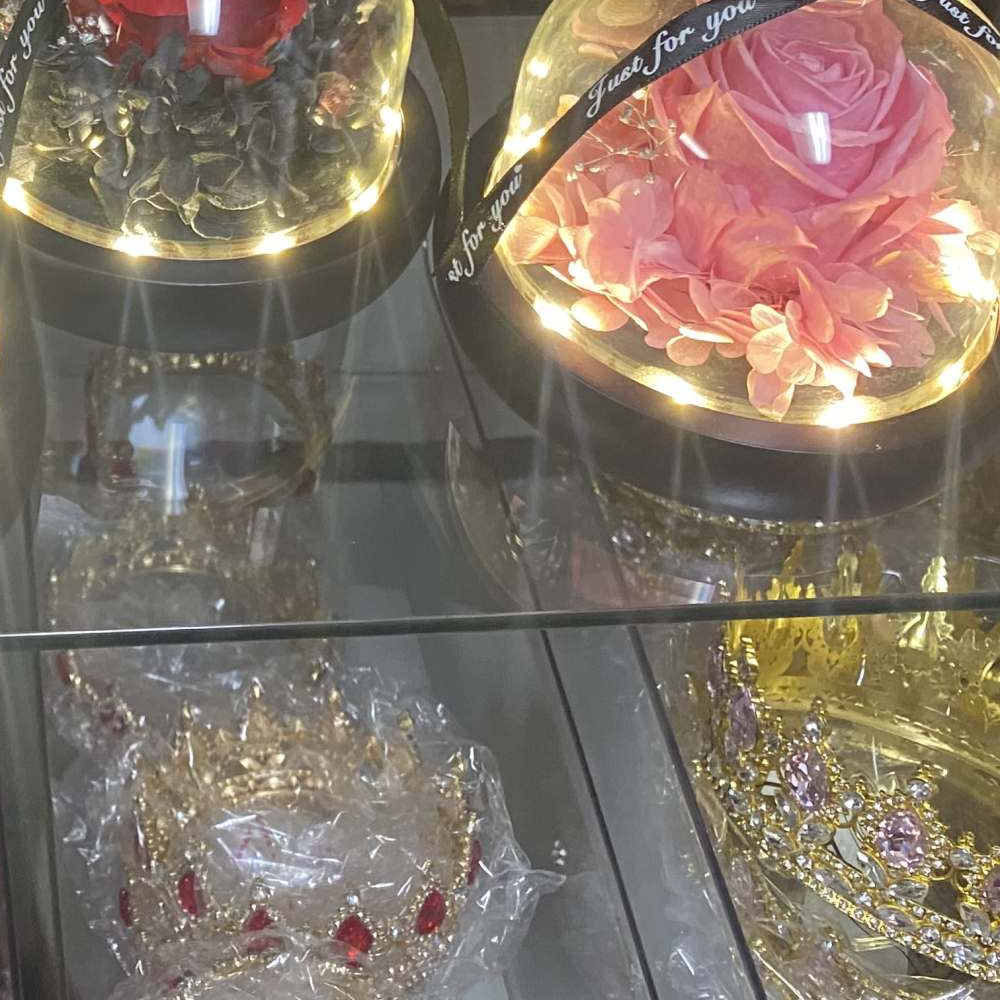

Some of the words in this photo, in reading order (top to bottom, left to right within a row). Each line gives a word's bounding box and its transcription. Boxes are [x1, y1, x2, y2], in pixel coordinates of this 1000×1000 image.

[0, 52, 18, 114] for
[19, 0, 47, 60] you
[586, 53, 645, 119] Just
[641, 29, 696, 76] for
[461, 228, 486, 278] for
[490, 173, 523, 233] you
